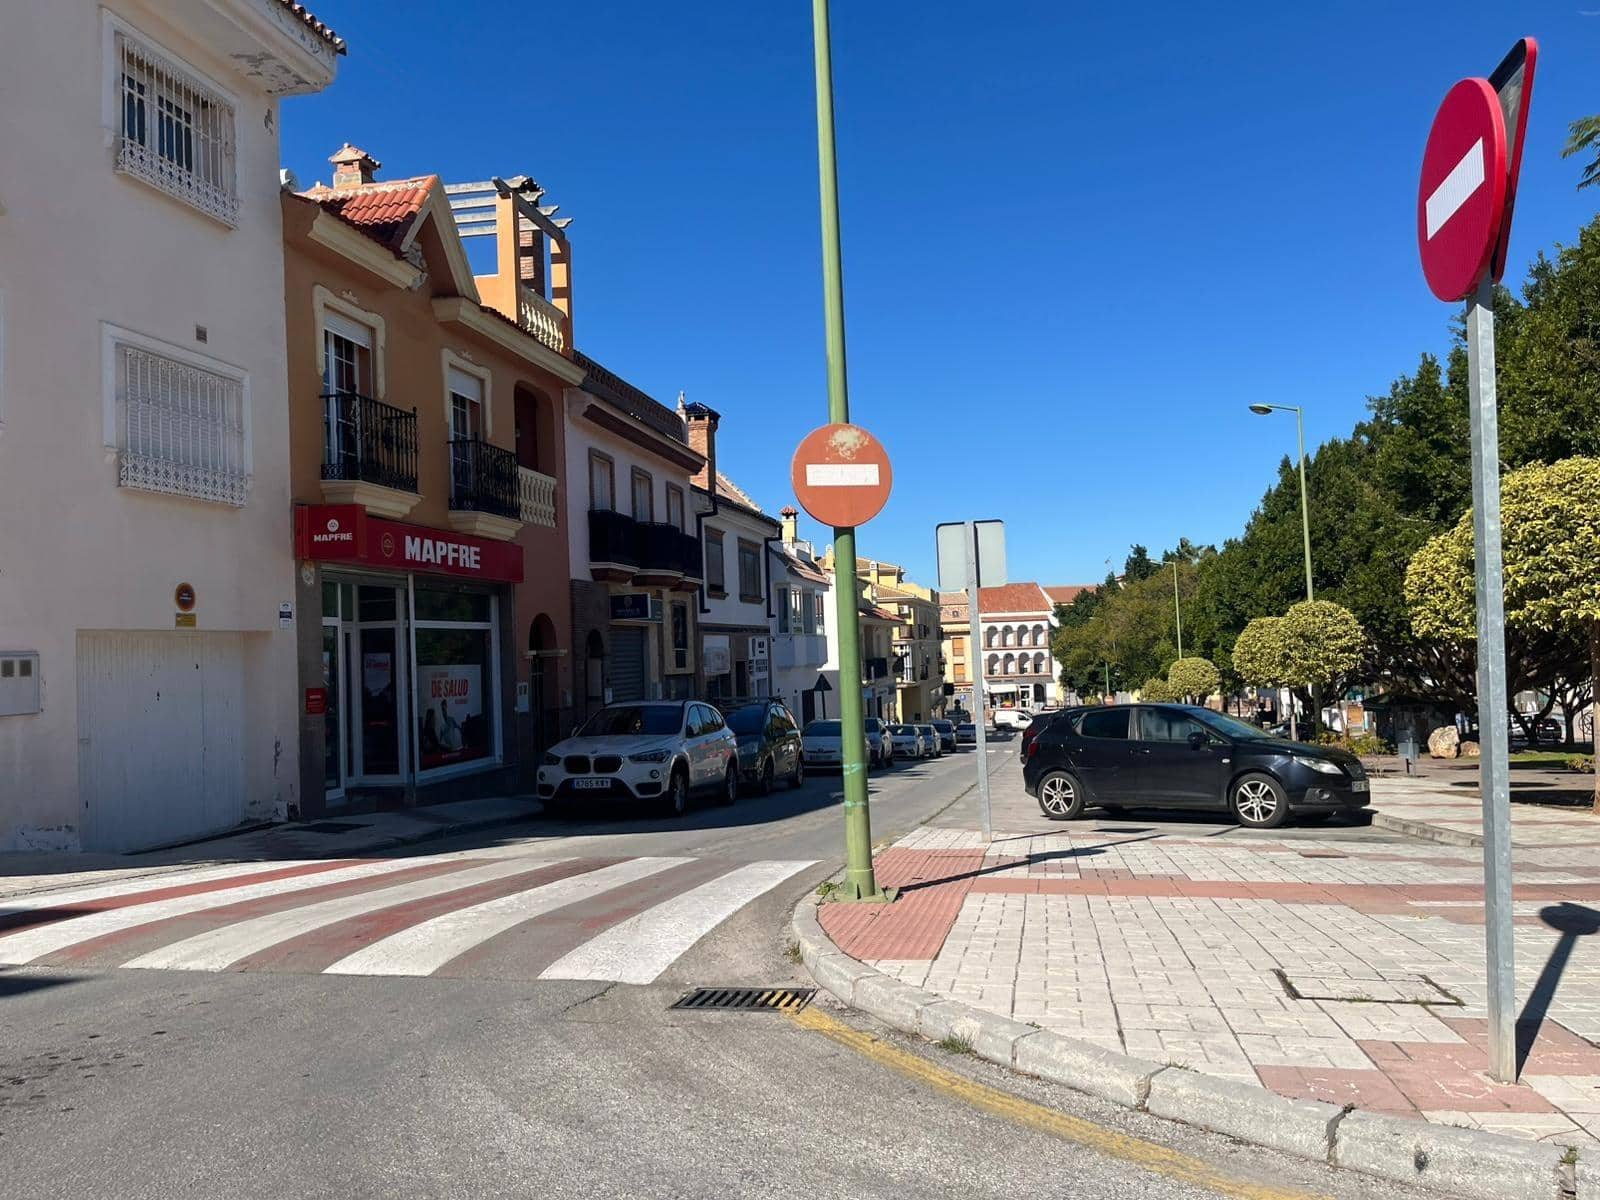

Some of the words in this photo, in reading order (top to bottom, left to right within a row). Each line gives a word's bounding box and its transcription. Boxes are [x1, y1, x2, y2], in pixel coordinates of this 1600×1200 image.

[314, 533, 353, 542] MAPFRE
[404, 535, 481, 569] MAPFRE
[432, 679, 442, 698] DE
[443, 678, 469, 698] SALUD
